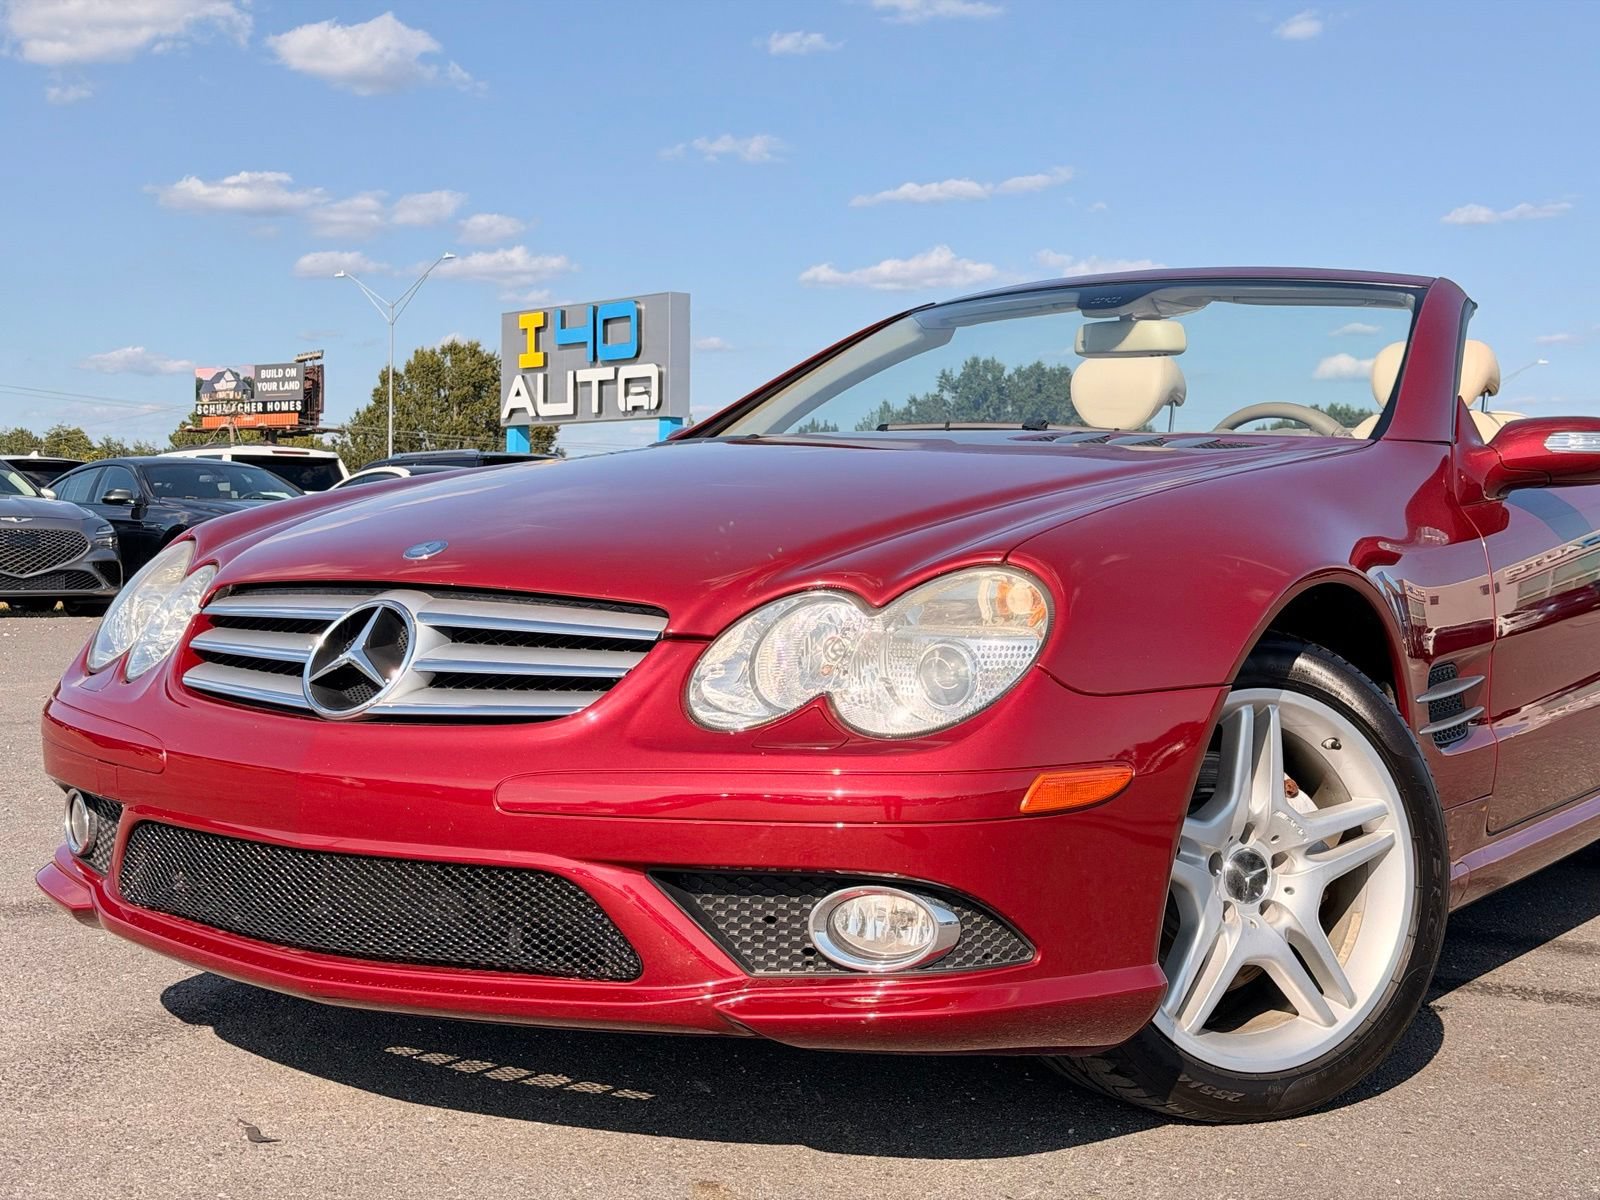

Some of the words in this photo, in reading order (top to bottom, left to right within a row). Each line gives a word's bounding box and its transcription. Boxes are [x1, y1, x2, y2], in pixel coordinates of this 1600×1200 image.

[260, 369, 283, 379] BUILD
[285, 367, 297, 378] ON
[257, 382, 278, 392] YOUR
[279, 381, 300, 391] LAND
[501, 363, 659, 419] AUTO
[266, 400, 302, 412] HOMES
